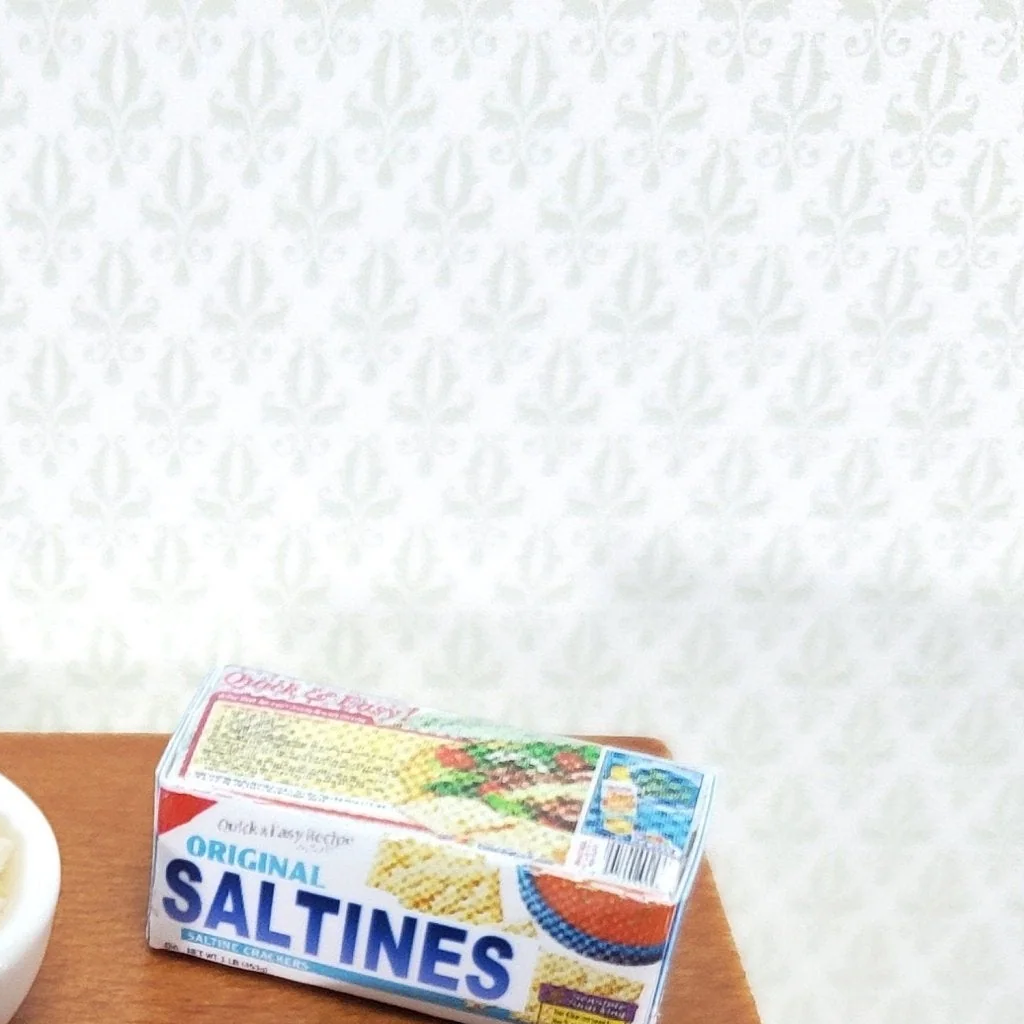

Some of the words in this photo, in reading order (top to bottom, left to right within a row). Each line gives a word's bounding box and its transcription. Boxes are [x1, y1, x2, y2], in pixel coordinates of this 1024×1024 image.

[186, 834, 325, 889] ORIGINAL
[161, 858, 514, 1000] SALTINES
[187, 931, 239, 953] SALTINE
[242, 946, 310, 971] CRACKERS
